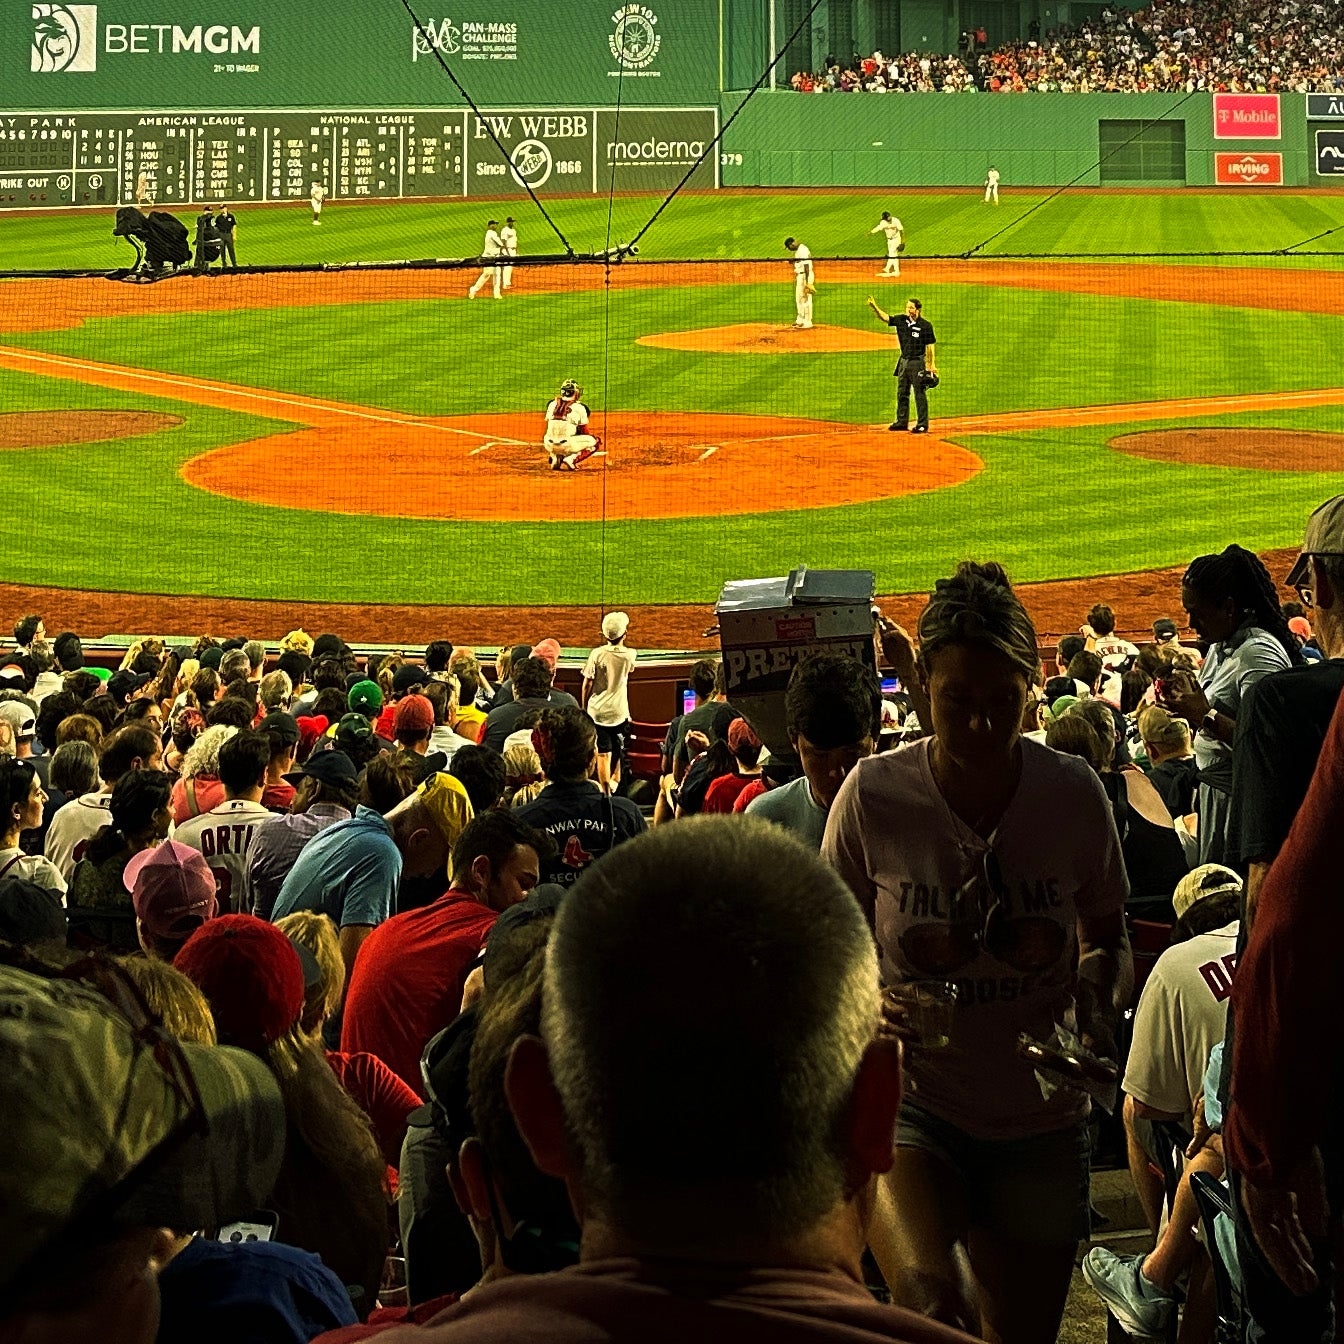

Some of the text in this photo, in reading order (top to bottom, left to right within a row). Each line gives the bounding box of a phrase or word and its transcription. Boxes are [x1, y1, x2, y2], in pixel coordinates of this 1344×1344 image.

[462, 22, 517, 33] PAN-MASS
[106, 24, 260, 54] BETMGM
[462, 33, 517, 44] CHALLENGE
[30, 118, 76, 127] PARK
[138, 116, 245, 126] AMERICAN LEAGUE
[320, 115, 415, 124] NATIONAL LEAGUE
[1231, 109, 1277, 123] Mobile
[522, 116, 588, 137] WEBB
[607, 137, 706, 159] moderna
[720, 153, 743, 166] 379
[476, 161, 582, 175] Since 1866
[1228, 162, 1269, 175] IRVING
[27, 178, 49, 188] OUT
[727, 641, 866, 688] PRETL
[544, 818, 582, 835] NWAY
[200, 824, 255, 857] ORTI
